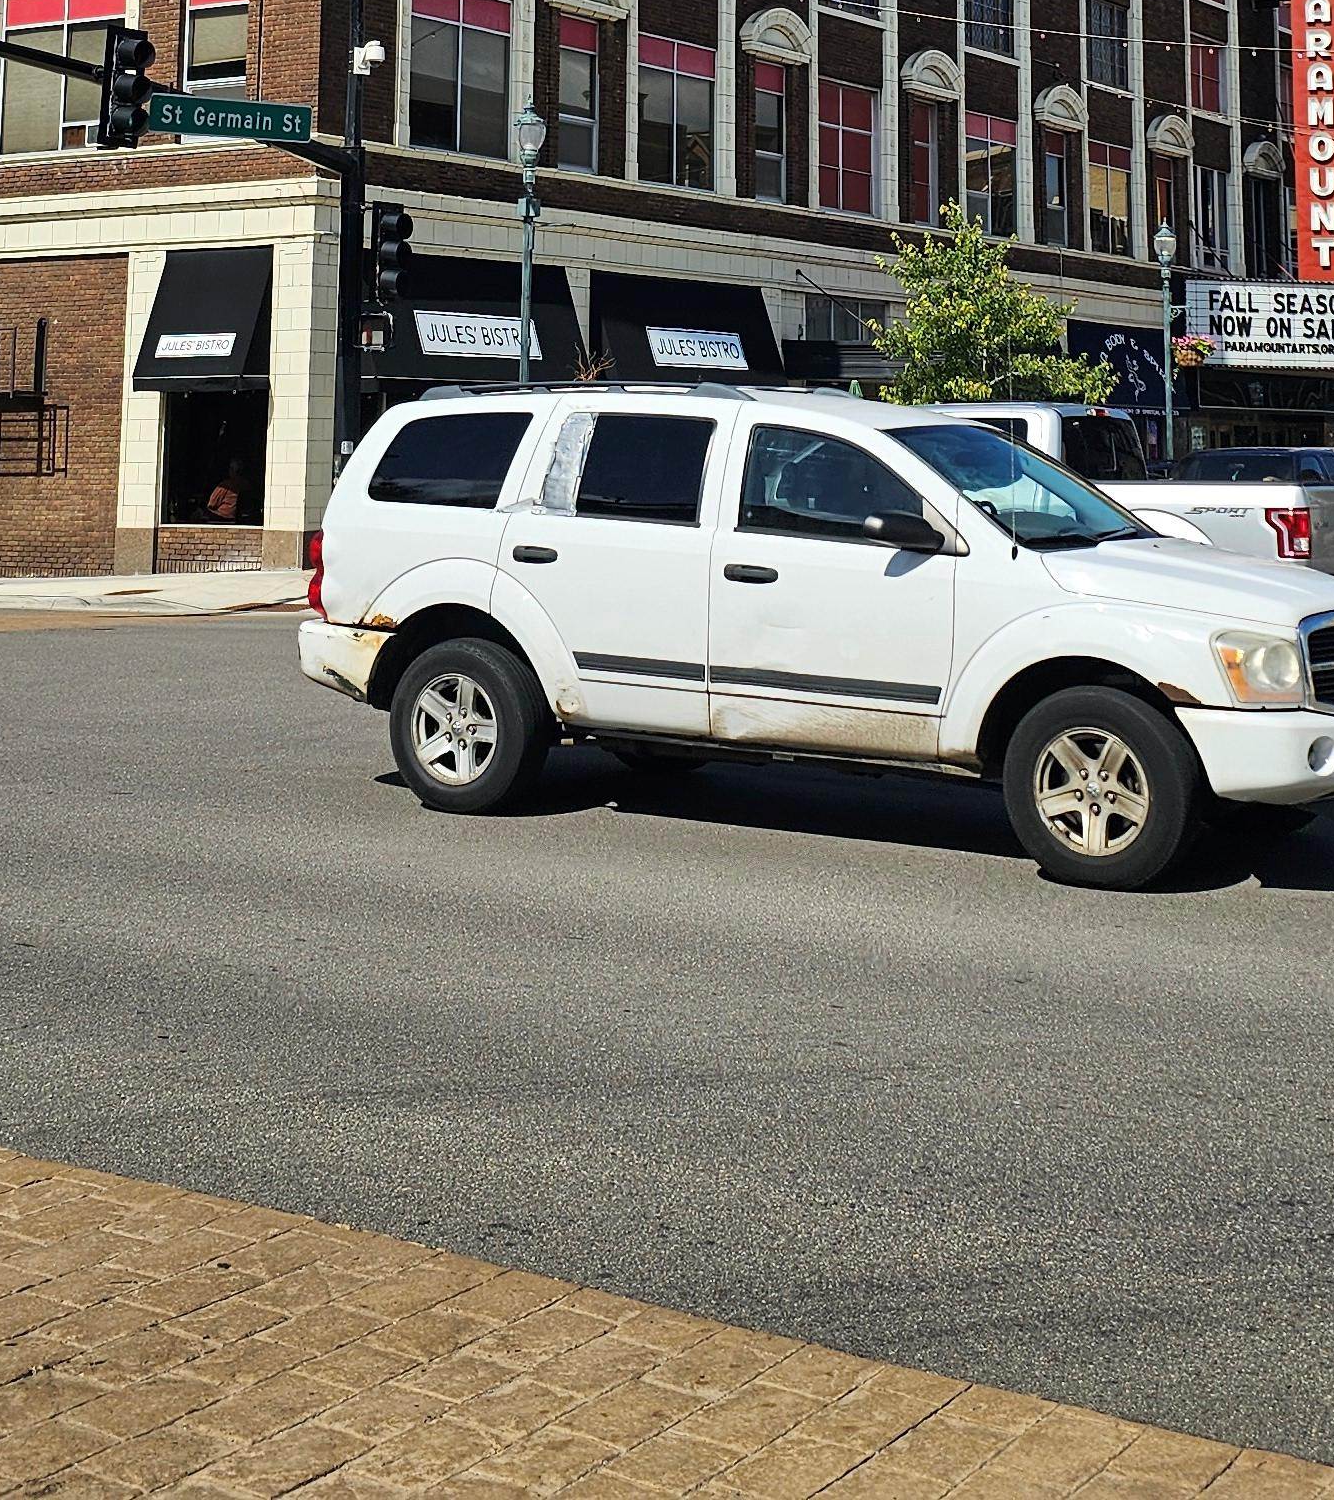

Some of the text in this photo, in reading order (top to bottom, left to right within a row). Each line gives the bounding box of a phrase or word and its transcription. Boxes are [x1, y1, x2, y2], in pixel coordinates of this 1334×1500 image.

[160, 104, 302, 134] St Germain St
[1208, 290, 1259, 314] FALL
[426, 323, 530, 347] JULES' BISTR
[1209, 315, 1253, 338] NOW
[1266, 316, 1292, 340] ON
[195, 339, 230, 351] BISTRO
[657, 337, 740, 360] JULES' BISTRO
[1104, 333, 1126, 351] BODY
[1184, 506, 1255, 515] SPORT
